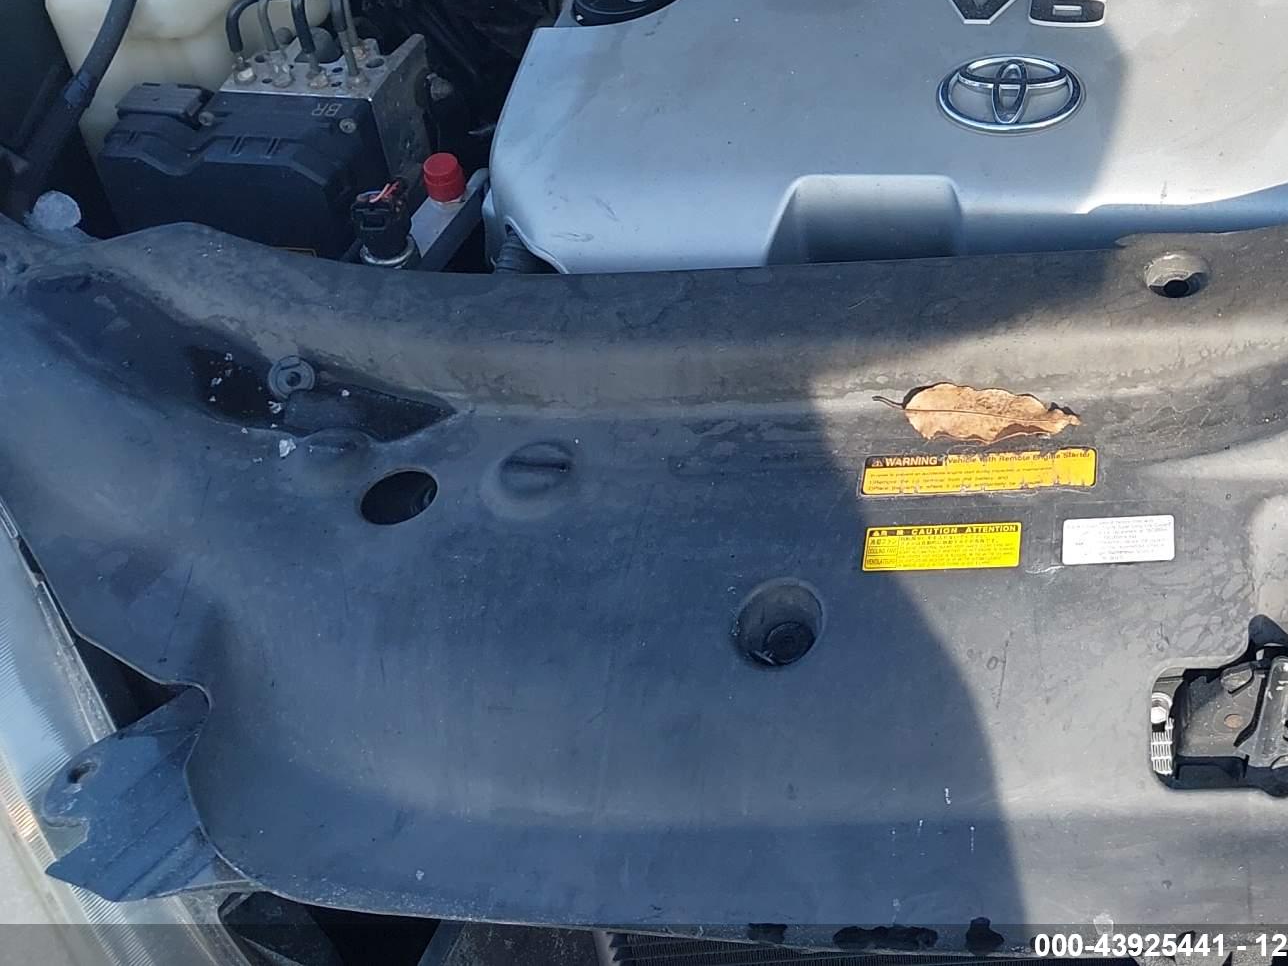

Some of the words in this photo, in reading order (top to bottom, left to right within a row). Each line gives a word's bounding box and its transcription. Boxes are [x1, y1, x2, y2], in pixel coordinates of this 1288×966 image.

[885, 456, 938, 467] WARNING
[911, 527, 957, 535] CAUTION
[965, 525, 1016, 534] ATTENTION
